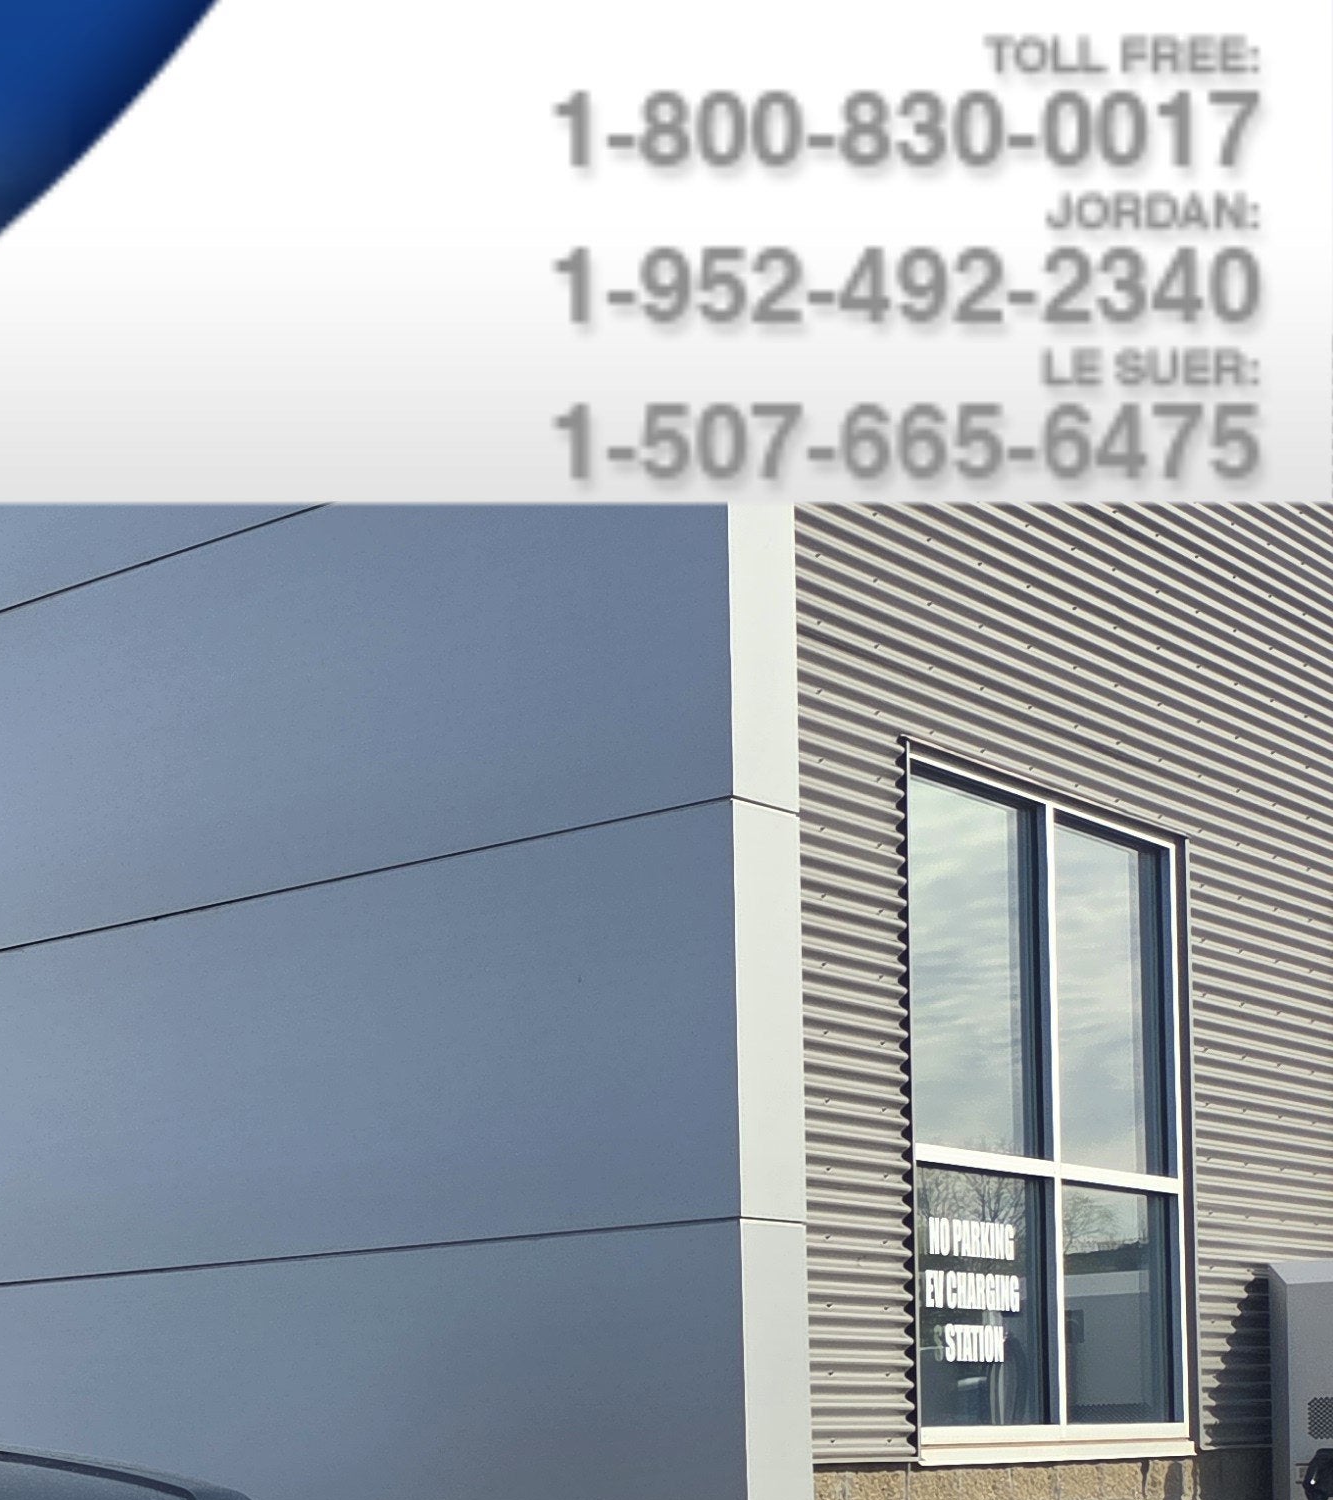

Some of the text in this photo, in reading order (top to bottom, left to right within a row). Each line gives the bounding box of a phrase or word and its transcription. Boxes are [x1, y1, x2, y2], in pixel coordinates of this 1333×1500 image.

[928, 1216, 1016, 1261] NO PARKING
[924, 1269, 1021, 1313] EV CHARGING
[944, 1322, 1005, 1363] STATION
